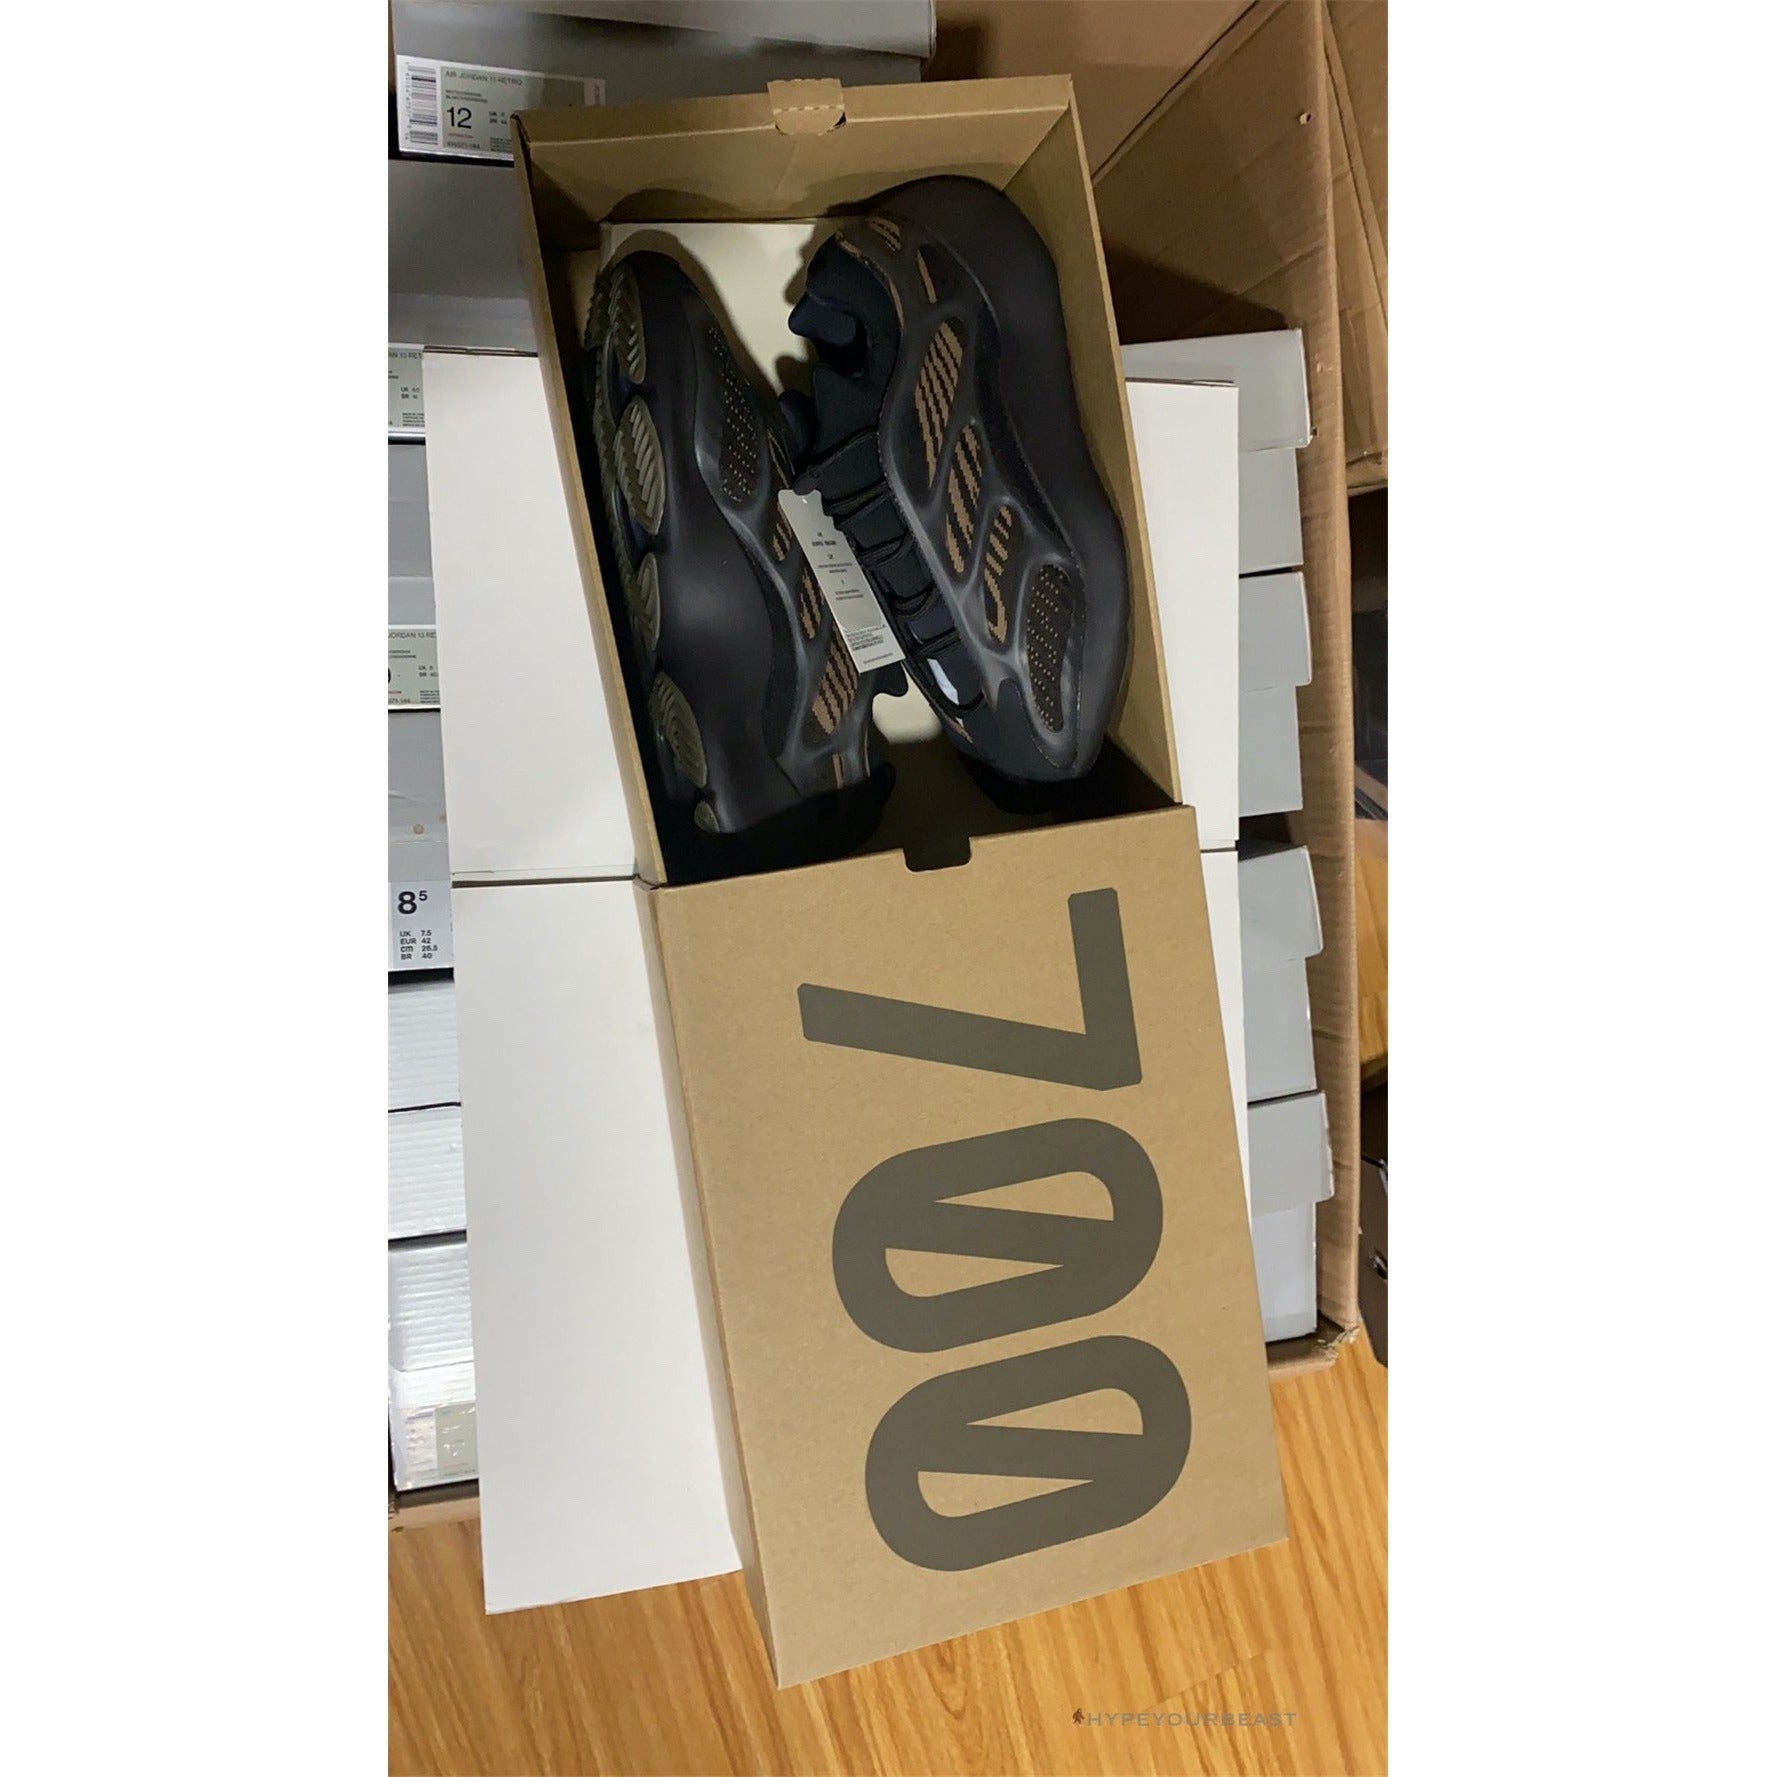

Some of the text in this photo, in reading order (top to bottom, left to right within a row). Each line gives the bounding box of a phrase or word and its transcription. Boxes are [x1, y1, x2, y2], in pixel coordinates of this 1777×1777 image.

[447, 106, 472, 129] 12
[421, 929, 432, 937] 7.5
[797, 887, 1192, 1572] 700
